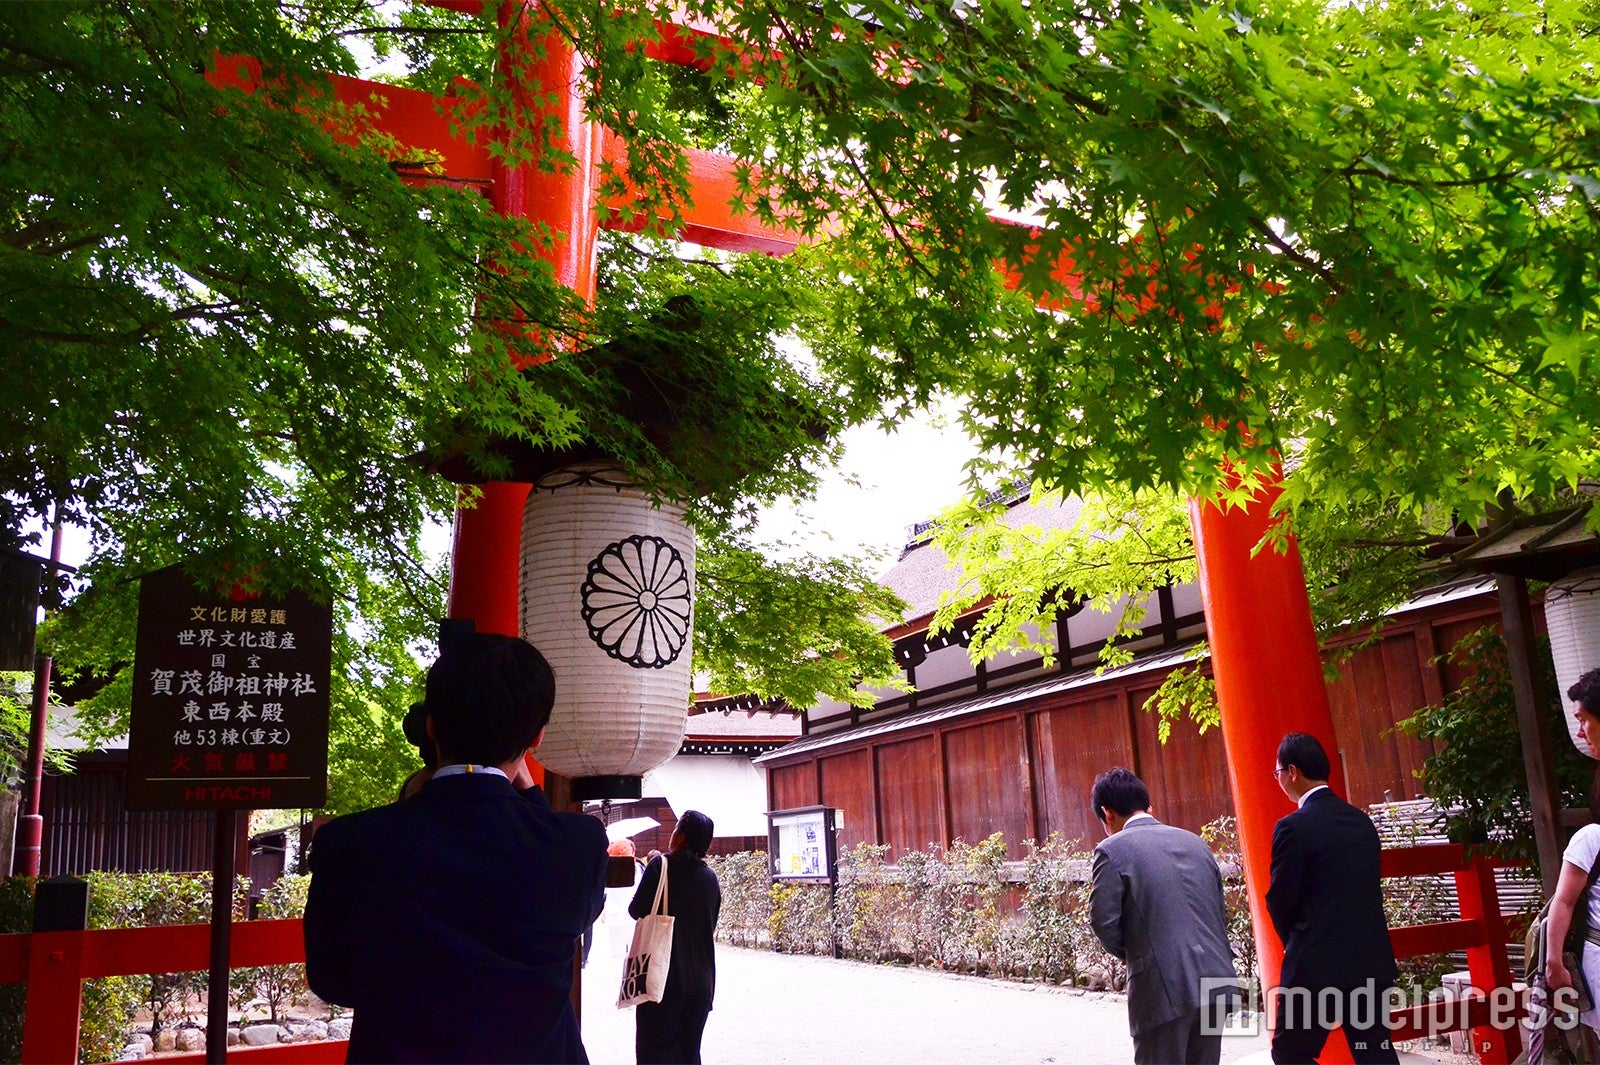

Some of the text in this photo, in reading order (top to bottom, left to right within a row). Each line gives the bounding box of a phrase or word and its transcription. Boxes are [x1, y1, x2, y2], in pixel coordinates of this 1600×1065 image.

[190, 606, 287, 625] 文化財愛護
[177, 629, 297, 650] 世界文化遺産
[150, 669, 317, 697] 賀茂御祖神社
[180, 700, 285, 723] 東西本殿
[171, 752, 289, 773] 火気厳禁
[185, 785, 272, 801] HITACHI
